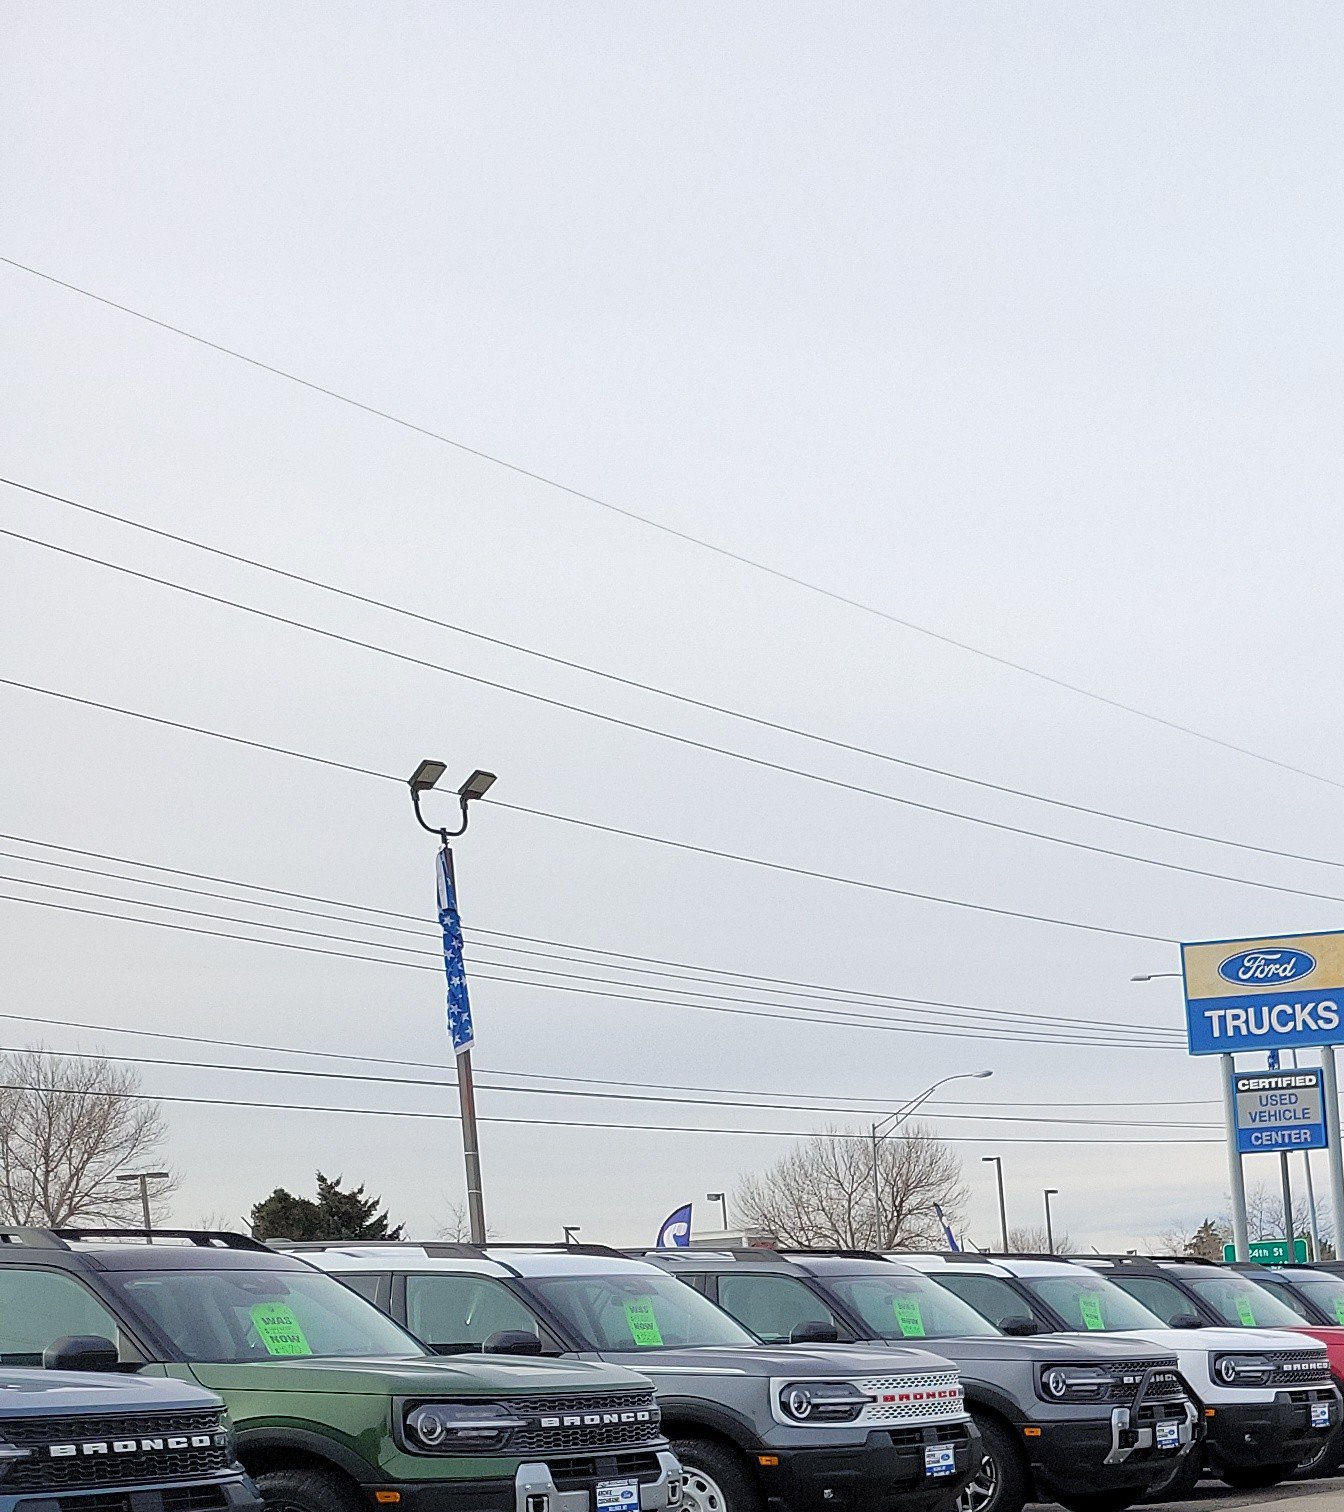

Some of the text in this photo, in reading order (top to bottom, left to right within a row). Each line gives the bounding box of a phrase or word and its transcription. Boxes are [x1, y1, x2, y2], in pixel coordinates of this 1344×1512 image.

[1238, 953, 1297, 980] Ford
[1204, 1001, 1340, 1038] TRUCKS
[1237, 1076, 1317, 1090] CERTIFIED
[1259, 1093, 1298, 1107] USED
[1249, 1107, 1311, 1123] VEHICLE
[1251, 1130, 1311, 1145] CENTER
[1273, 1247, 1283, 1256] St
[261, 1316, 292, 1325] WAS
[270, 1335, 301, 1343] NOW
[1283, 1363, 1328, 1371] BRONCO
[1123, 1374, 1177, 1384] BRNC
[882, 1390, 957, 1402] BRONCO
[541, 1412, 650, 1428] BRONCO
[50, 1435, 210, 1457] BRONCO
